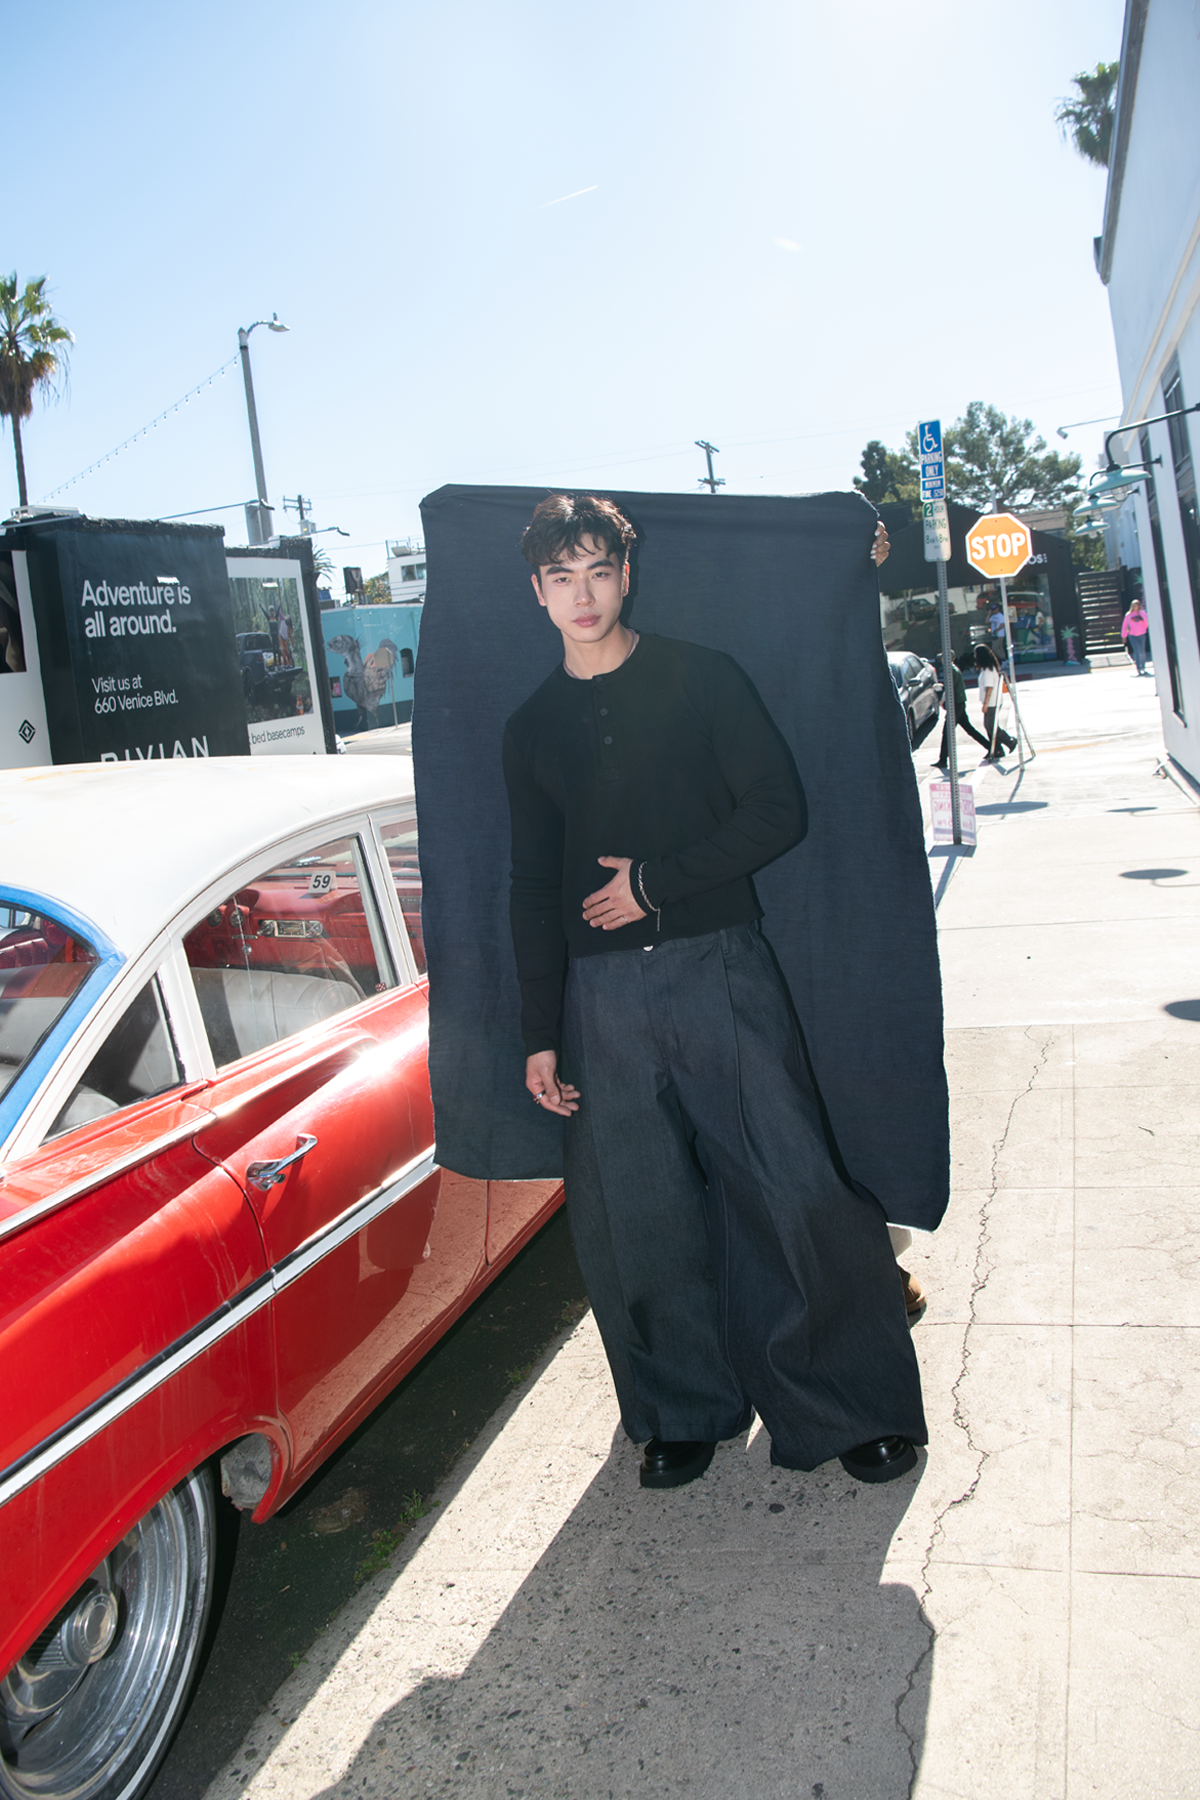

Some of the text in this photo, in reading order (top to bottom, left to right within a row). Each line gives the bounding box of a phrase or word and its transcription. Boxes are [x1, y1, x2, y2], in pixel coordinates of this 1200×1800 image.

[925, 465, 939, 477] ONLY
[925, 503, 932, 516] 2
[925, 517, 948, 530] PARKING
[970, 532, 1026, 560] STOP
[81, 579, 192, 607] Adventure is
[84, 608, 177, 638] all around.
[91, 674, 143, 694] Visit us at
[94, 688, 179, 714] 660 Venice Blvd.
[251, 729, 266, 745] bed
[266, 725, 306, 742] basecamps
[312, 874, 331, 889] 59
